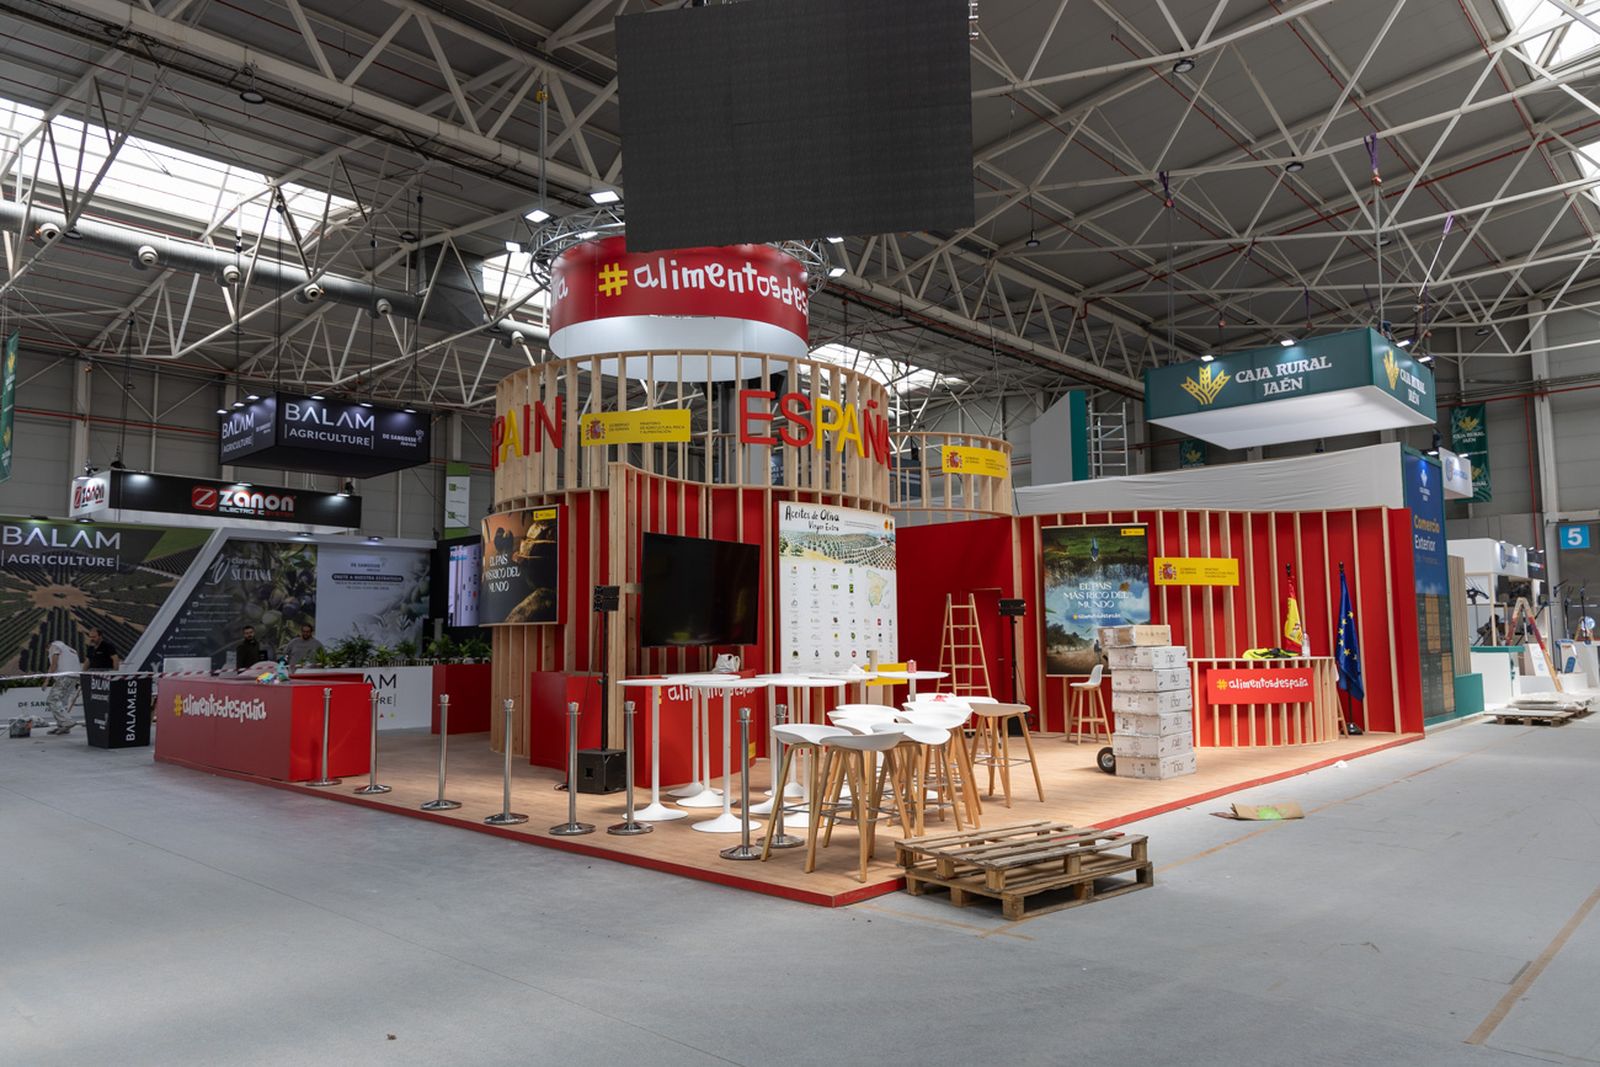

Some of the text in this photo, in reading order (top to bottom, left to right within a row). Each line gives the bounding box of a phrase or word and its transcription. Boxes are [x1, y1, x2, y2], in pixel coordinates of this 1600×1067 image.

[1236, 356, 1332, 384] CAJA RURAL
[1264, 378, 1303, 397] JAÉN
[222, 411, 254, 440] BALAM
[285, 402, 375, 432] BALAM
[289, 427, 370, 447] AGRICULTURE
[491, 394, 563, 471] PAIN
[785, 506, 839, 522] Aceites de Oliva
[1414, 515, 1441, 533] Comercio
[2, 525, 120, 550] BALAM
[1415, 534, 1436, 551] Exterior
[1568, 528, 1583, 546] 5
[7, 553, 116, 567] AGRICULTURE
[231, 569, 273, 582] SULTANA
[1079, 583, 1090, 591] EL
[1086, 591, 1110, 600] RICO
[1077, 601, 1115, 609] MUNDO
[1216, 677, 1308, 690] #alimentosdespaña
[126, 680, 138, 741] BALAM.ES
